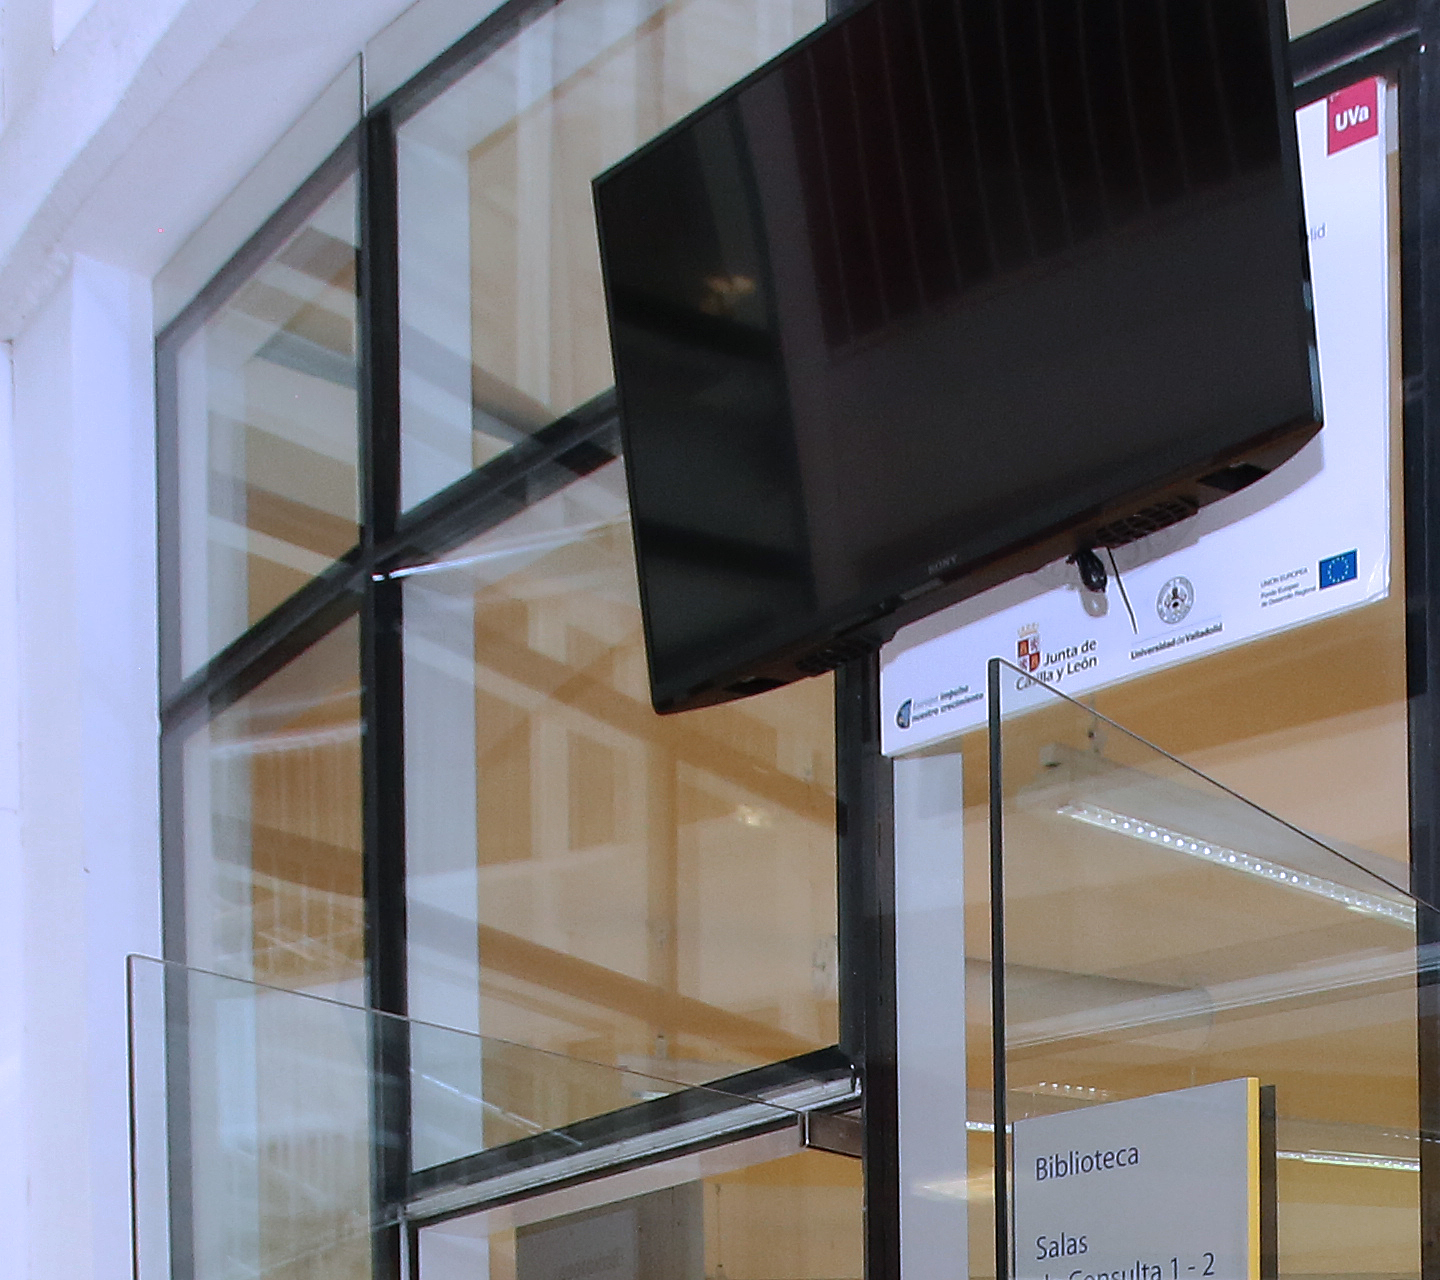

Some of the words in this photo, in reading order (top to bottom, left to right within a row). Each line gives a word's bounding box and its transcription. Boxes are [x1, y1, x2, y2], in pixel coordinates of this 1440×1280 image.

[1334, 104, 1371, 132] UVa
[1043, 646, 1078, 667] Junta
[1080, 639, 1097, 654] de
[1067, 656, 1097, 675] León
[1035, 1146, 1139, 1181] Biblioteca
[1036, 1232, 1088, 1260] Salas
[1170, 1257, 1178, 1280] 1
[1202, 1252, 1215, 1276] 2
